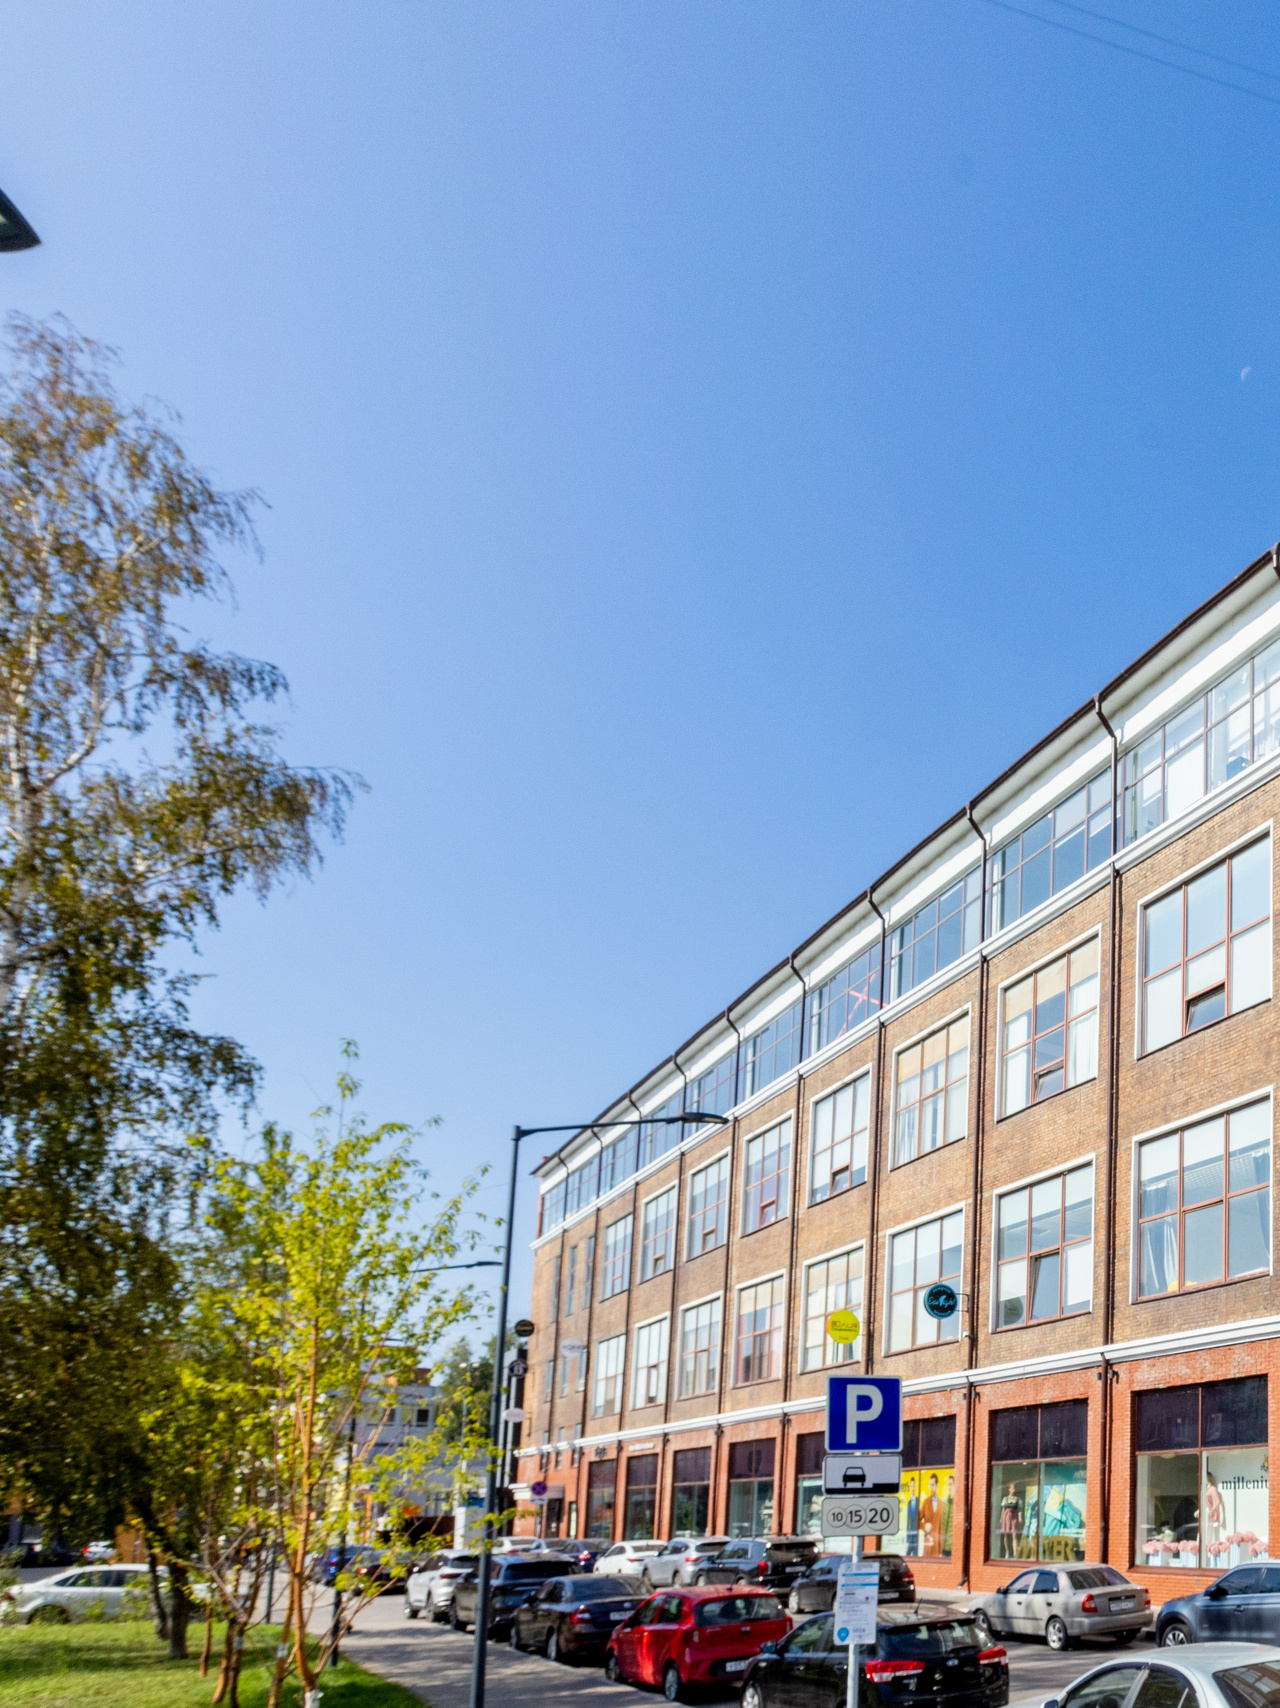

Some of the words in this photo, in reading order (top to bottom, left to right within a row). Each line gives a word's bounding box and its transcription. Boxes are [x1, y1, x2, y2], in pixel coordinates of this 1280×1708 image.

[846, 1384, 884, 1444] P
[832, 1512, 844, 1523] 10
[848, 1509, 863, 1523] 15
[868, 1507, 890, 1524] 20
[1014, 1535, 1076, 1562] MYER
